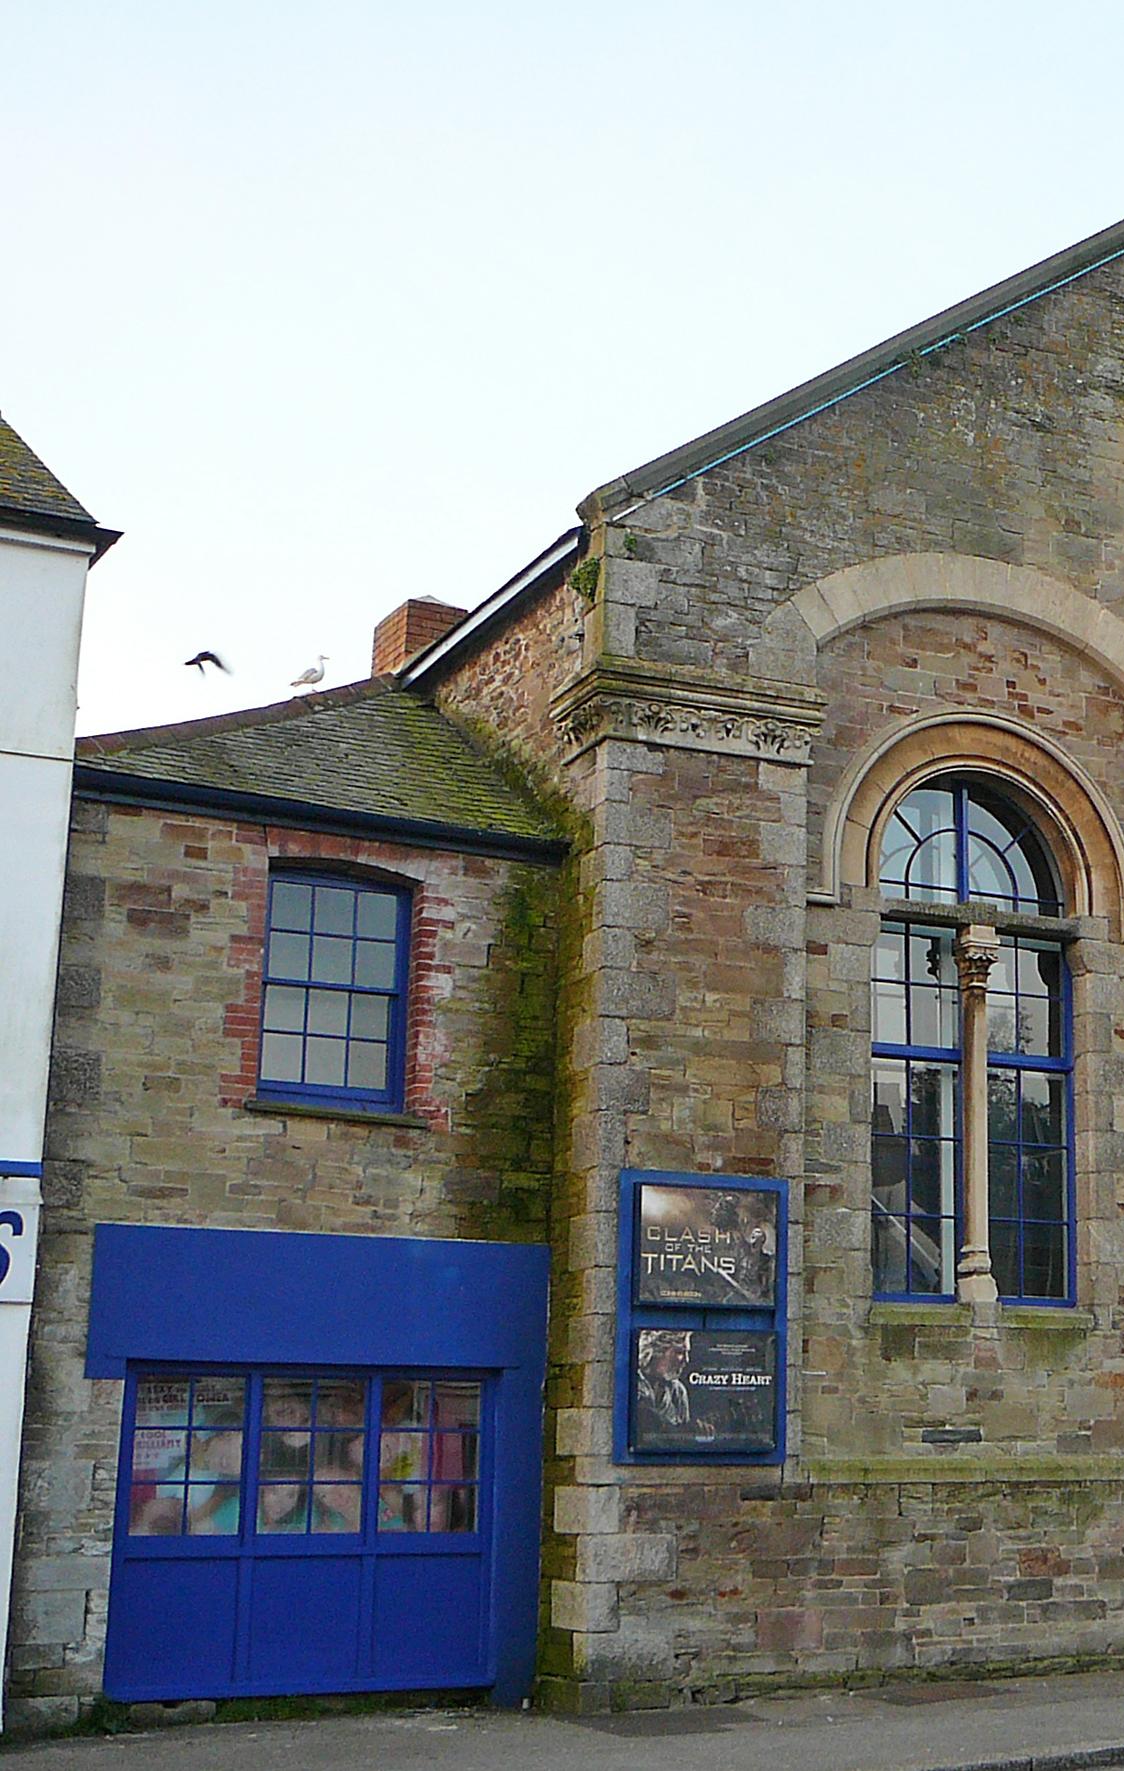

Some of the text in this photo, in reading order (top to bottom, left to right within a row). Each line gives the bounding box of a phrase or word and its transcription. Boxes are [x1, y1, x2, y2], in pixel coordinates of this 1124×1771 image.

[646, 1225, 731, 1244] CLASH
[664, 1242, 712, 1254] OF THE
[640, 1253, 736, 1276] TITANS
[688, 1372, 772, 1385] CRAZY HEART
